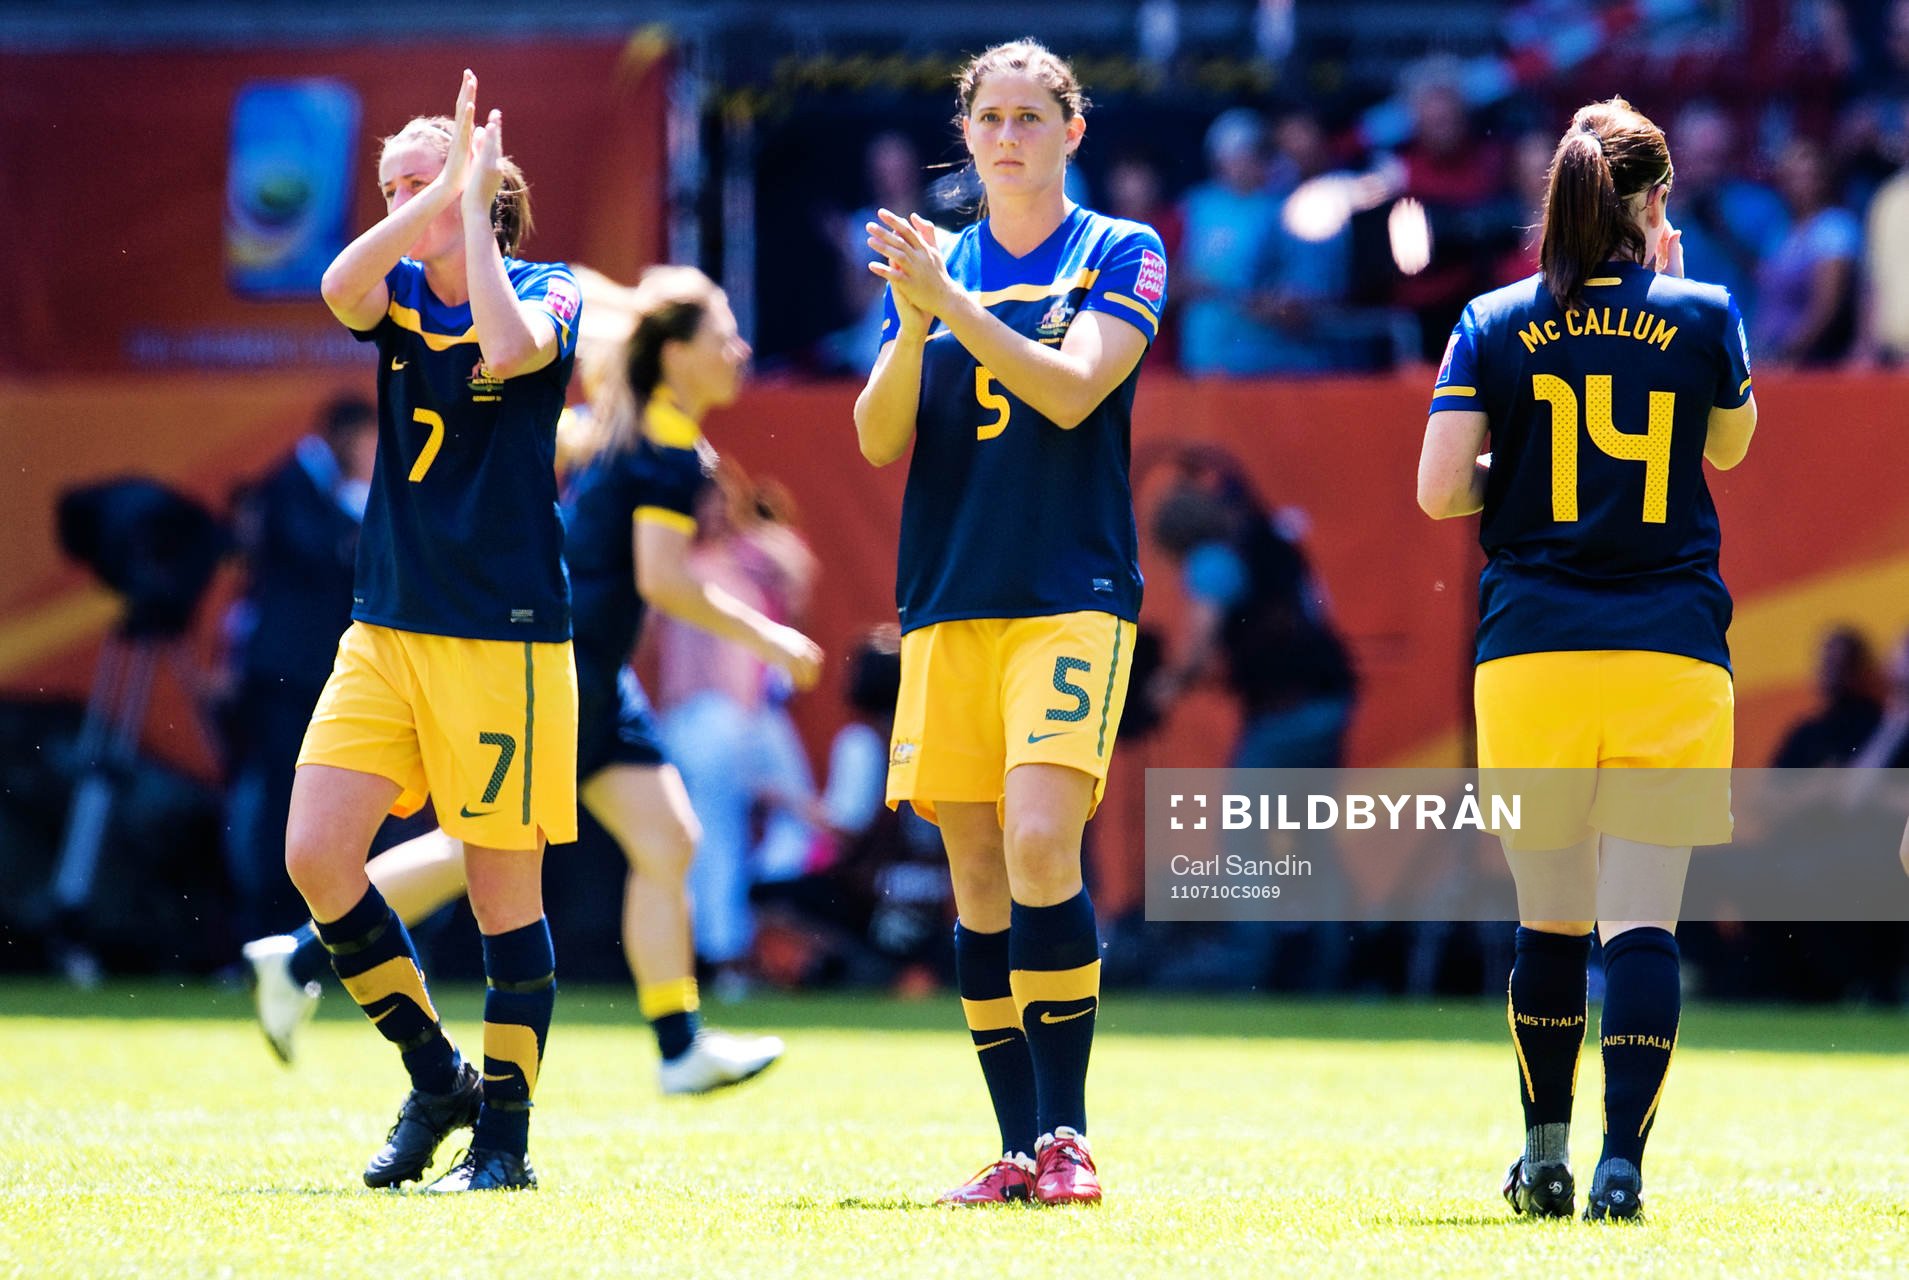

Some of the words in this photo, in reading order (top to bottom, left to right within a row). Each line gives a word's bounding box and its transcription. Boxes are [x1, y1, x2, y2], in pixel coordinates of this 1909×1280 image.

[1565, 307, 1679, 352] CALLUM
[976, 366, 1011, 441] 5
[408, 407, 445, 483] 7
[1532, 373, 1676, 524] 14
[1045, 656, 1091, 723] 5
[479, 731, 517, 804] 7
[1516, 1012, 1584, 1027] AUSTRALIA
[1603, 1035, 1671, 1051] AUSTRALIA
